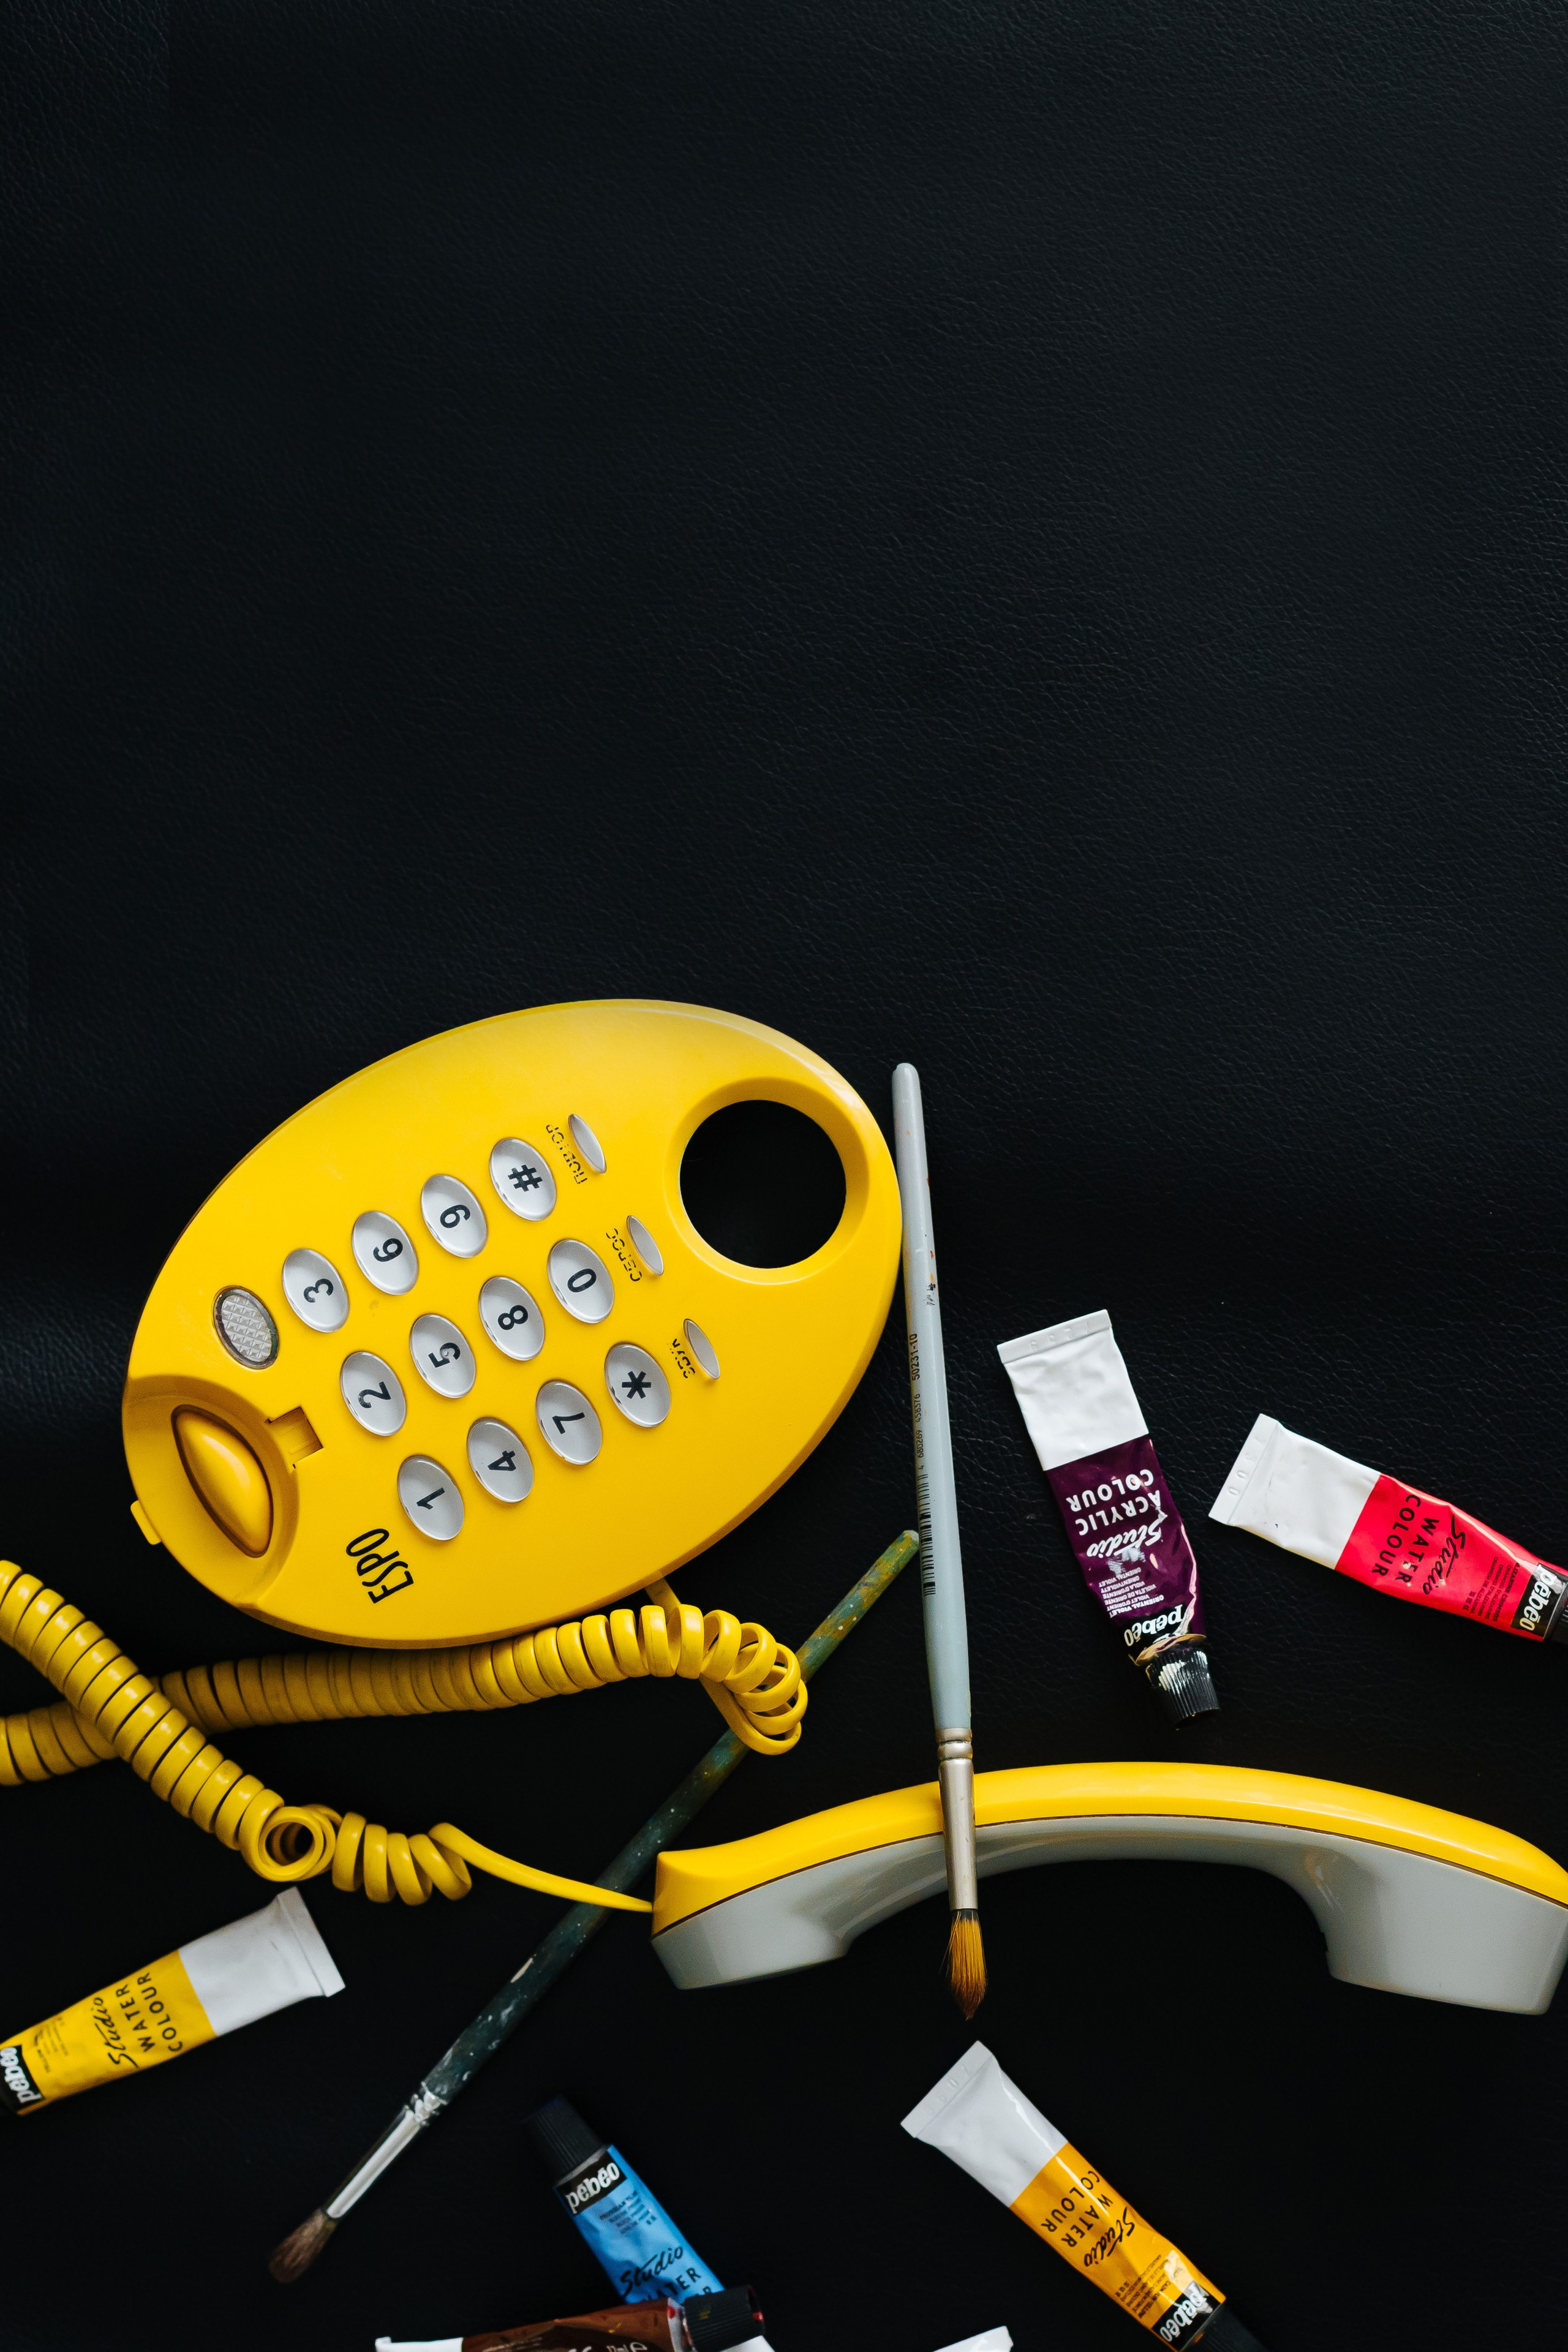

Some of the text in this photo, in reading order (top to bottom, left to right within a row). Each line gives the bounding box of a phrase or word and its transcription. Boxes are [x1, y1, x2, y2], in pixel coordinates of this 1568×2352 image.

[440, 1205, 470, 1228] 9
[374, 1238, 403, 1261] 6
[304, 1279, 333, 1302] 3
[568, 1268, 597, 1292] 0
[498, 1305, 528, 1330] 8
[429, 1343, 460, 1368] 5
[909, 1333, 920, 1381] 50231-10
[359, 1382, 391, 1408] 2
[552, 1412, 585, 1434] 7
[915, 1430, 924, 1459] 680269
[488, 1450, 516, 1471] 4
[417, 1488, 445, 1509] 1
[1066, 1469, 1154, 1512] COLOUR
[1075, 1490, 1161, 1536] ACRYLIC
[1087, 1515, 1164, 1558] Studio
[1372, 1494, 1421, 1576] COLOUR
[346, 1528, 414, 1604] ESPO
[1395, 1518, 1439, 1588] WATER
[1422, 1514, 1466, 1595] Studio
[1099, 1567, 1141, 1587] ORIENTAL VIOLET
[1135, 1585, 1156, 1595] VIOLETA
[1104, 1595, 1127, 1605] ORIENTE
[1109, 1595, 1164, 1618] ORIENTAL VIOLET
[1131, 1594, 1150, 1604] VIOLET
[116, 1984, 155, 2052] WATER
[137, 1972, 183, 2052] COLOUR
[91, 1997, 138, 2068] Studio
[1040, 2170, 1101, 2233] COLOUR
[1061, 2193, 1114, 2248] WATER
[1084, 2207, 1135, 2267] Studio
[620, 2246, 683, 2298] Studio
